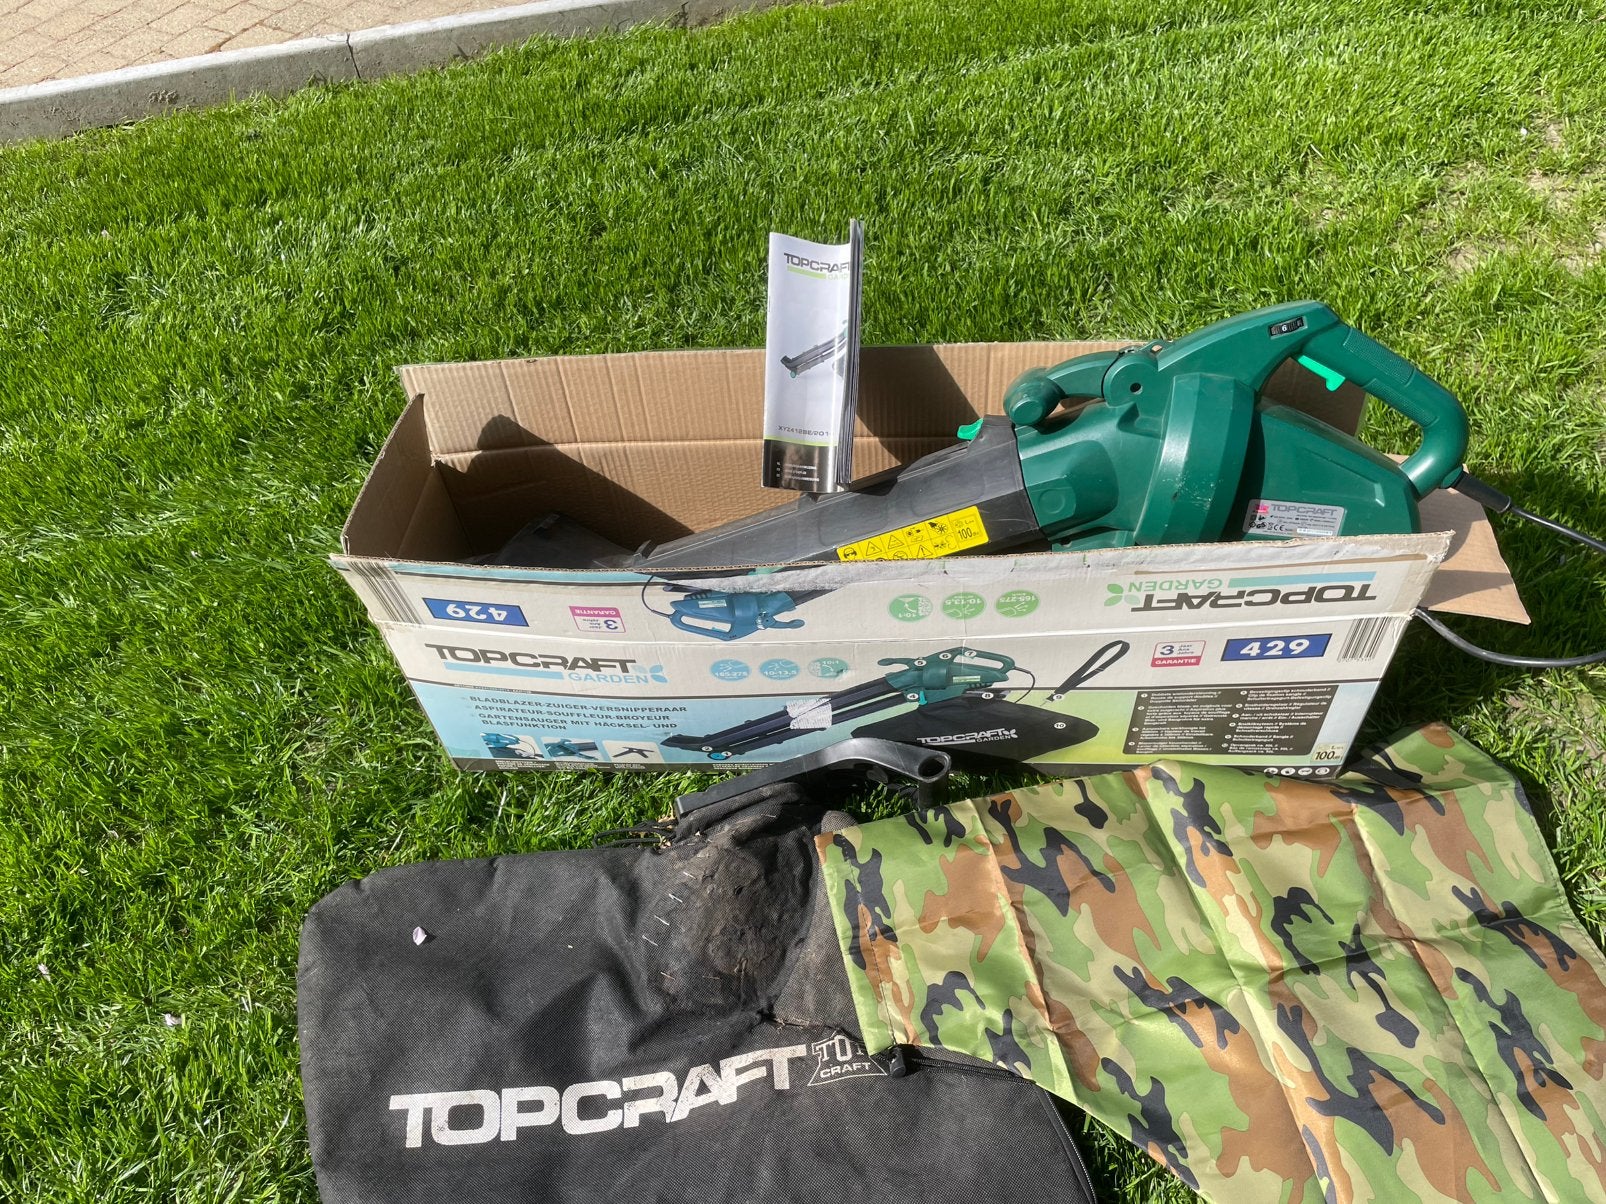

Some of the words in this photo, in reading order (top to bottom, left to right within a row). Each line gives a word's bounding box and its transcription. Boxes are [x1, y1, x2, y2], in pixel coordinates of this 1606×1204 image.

[1281, 324, 1288, 332] 6
[1271, 503, 1338, 516] TOPCRAFT
[958, 527, 973, 540] 100
[1128, 578, 1223, 592] GARDEN
[1131, 583, 1377, 612] TOPCRAFT
[446, 603, 508, 621] 429
[603, 619, 619, 630] 3
[1159, 644, 1175, 656] 3
[1239, 638, 1310, 657] 429
[424, 643, 637, 674] TOPCRAFT
[569, 671, 649, 685] GARDEN
[481, 719, 567, 730] BLASFUNKTION
[916, 728, 1006, 744] TOPCRAFT
[976, 735, 1011, 743] GARDEN
[1315, 751, 1336, 760] 100
[820, 1062, 871, 1078] CRAFT
[388, 1044, 807, 1149] TOPCRAFT
